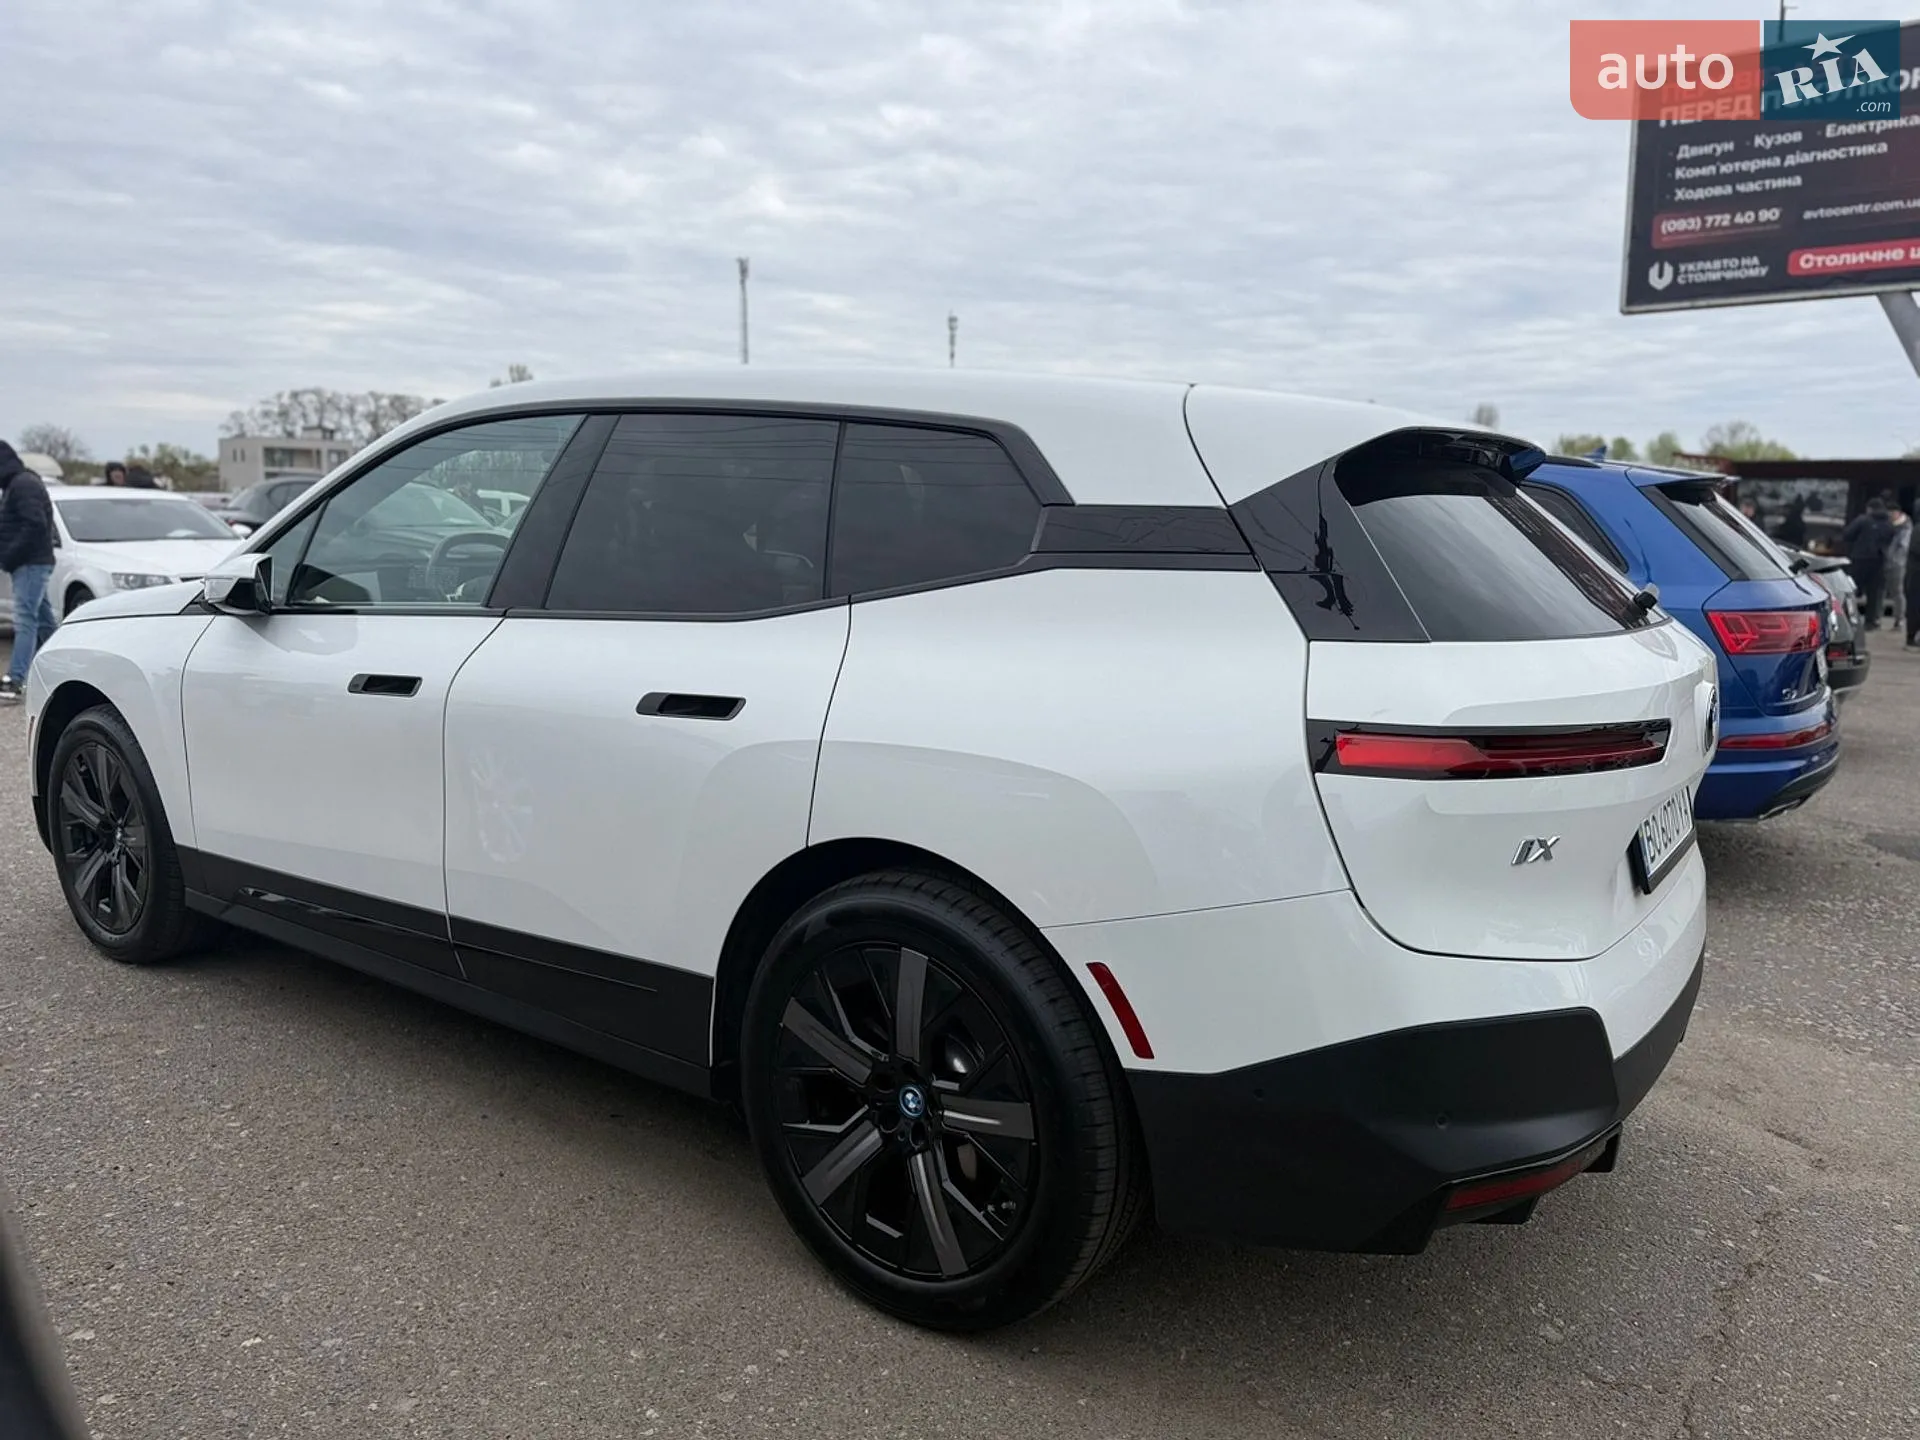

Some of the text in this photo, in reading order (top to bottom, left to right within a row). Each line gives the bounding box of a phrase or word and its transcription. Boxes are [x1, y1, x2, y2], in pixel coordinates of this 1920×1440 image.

[1753, 131, 1804, 150] Кузов
[1783, 142, 1889, 168] діагностика
[1674, 175, 1803, 202] Ходова частина
[1704, 213, 1732, 228] 772
[1734, 209, 1756, 224] 40
[1757, 207, 1780, 222] 90
[1740, 255, 1761, 267] НА
[1676, 264, 1770, 285] СТОЛИЧНОМУ
